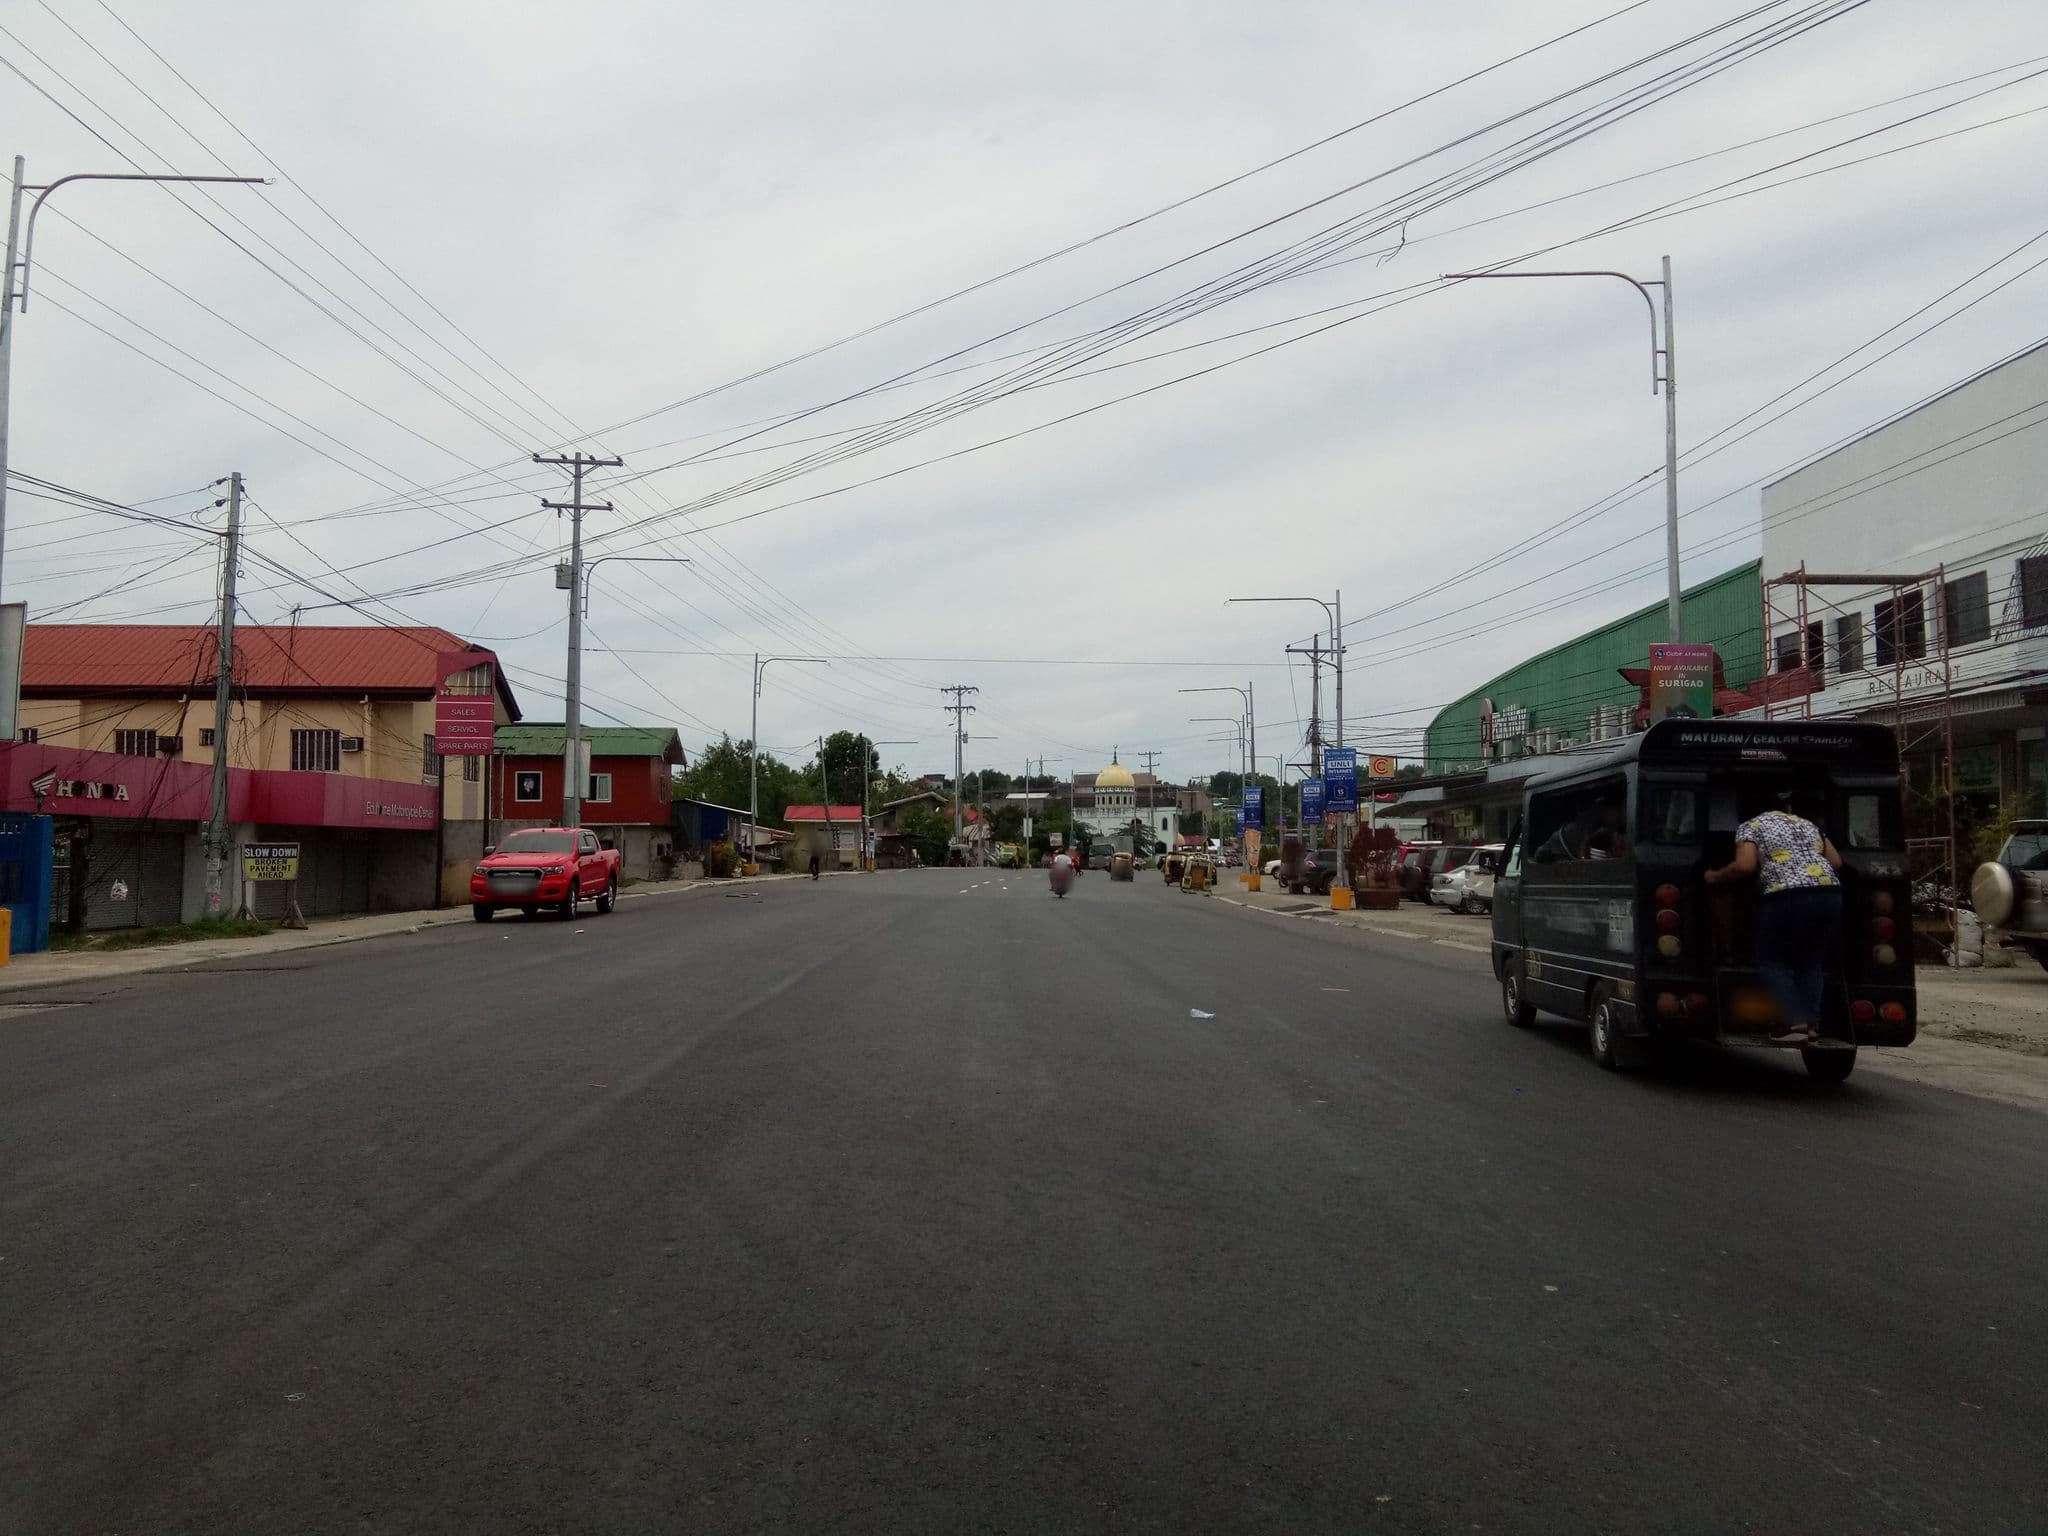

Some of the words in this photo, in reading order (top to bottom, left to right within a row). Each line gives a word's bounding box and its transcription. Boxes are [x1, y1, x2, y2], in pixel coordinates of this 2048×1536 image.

[1673, 664, 1709, 672] AVAILABLE
[1658, 679, 1704, 688] SURIGAO
[1869, 665, 1961, 695] RESAURAT
[451, 708, 476, 717] SALES
[448, 725, 480, 734] SERVICE
[438, 742, 463, 750] SPARE
[464, 742, 489, 750] PARTS
[56, 780, 130, 802] HNA
[244, 848, 270, 857] SLOW
[272, 848, 298, 857] DOWN
[257, 871, 284, 879] AHEAD
